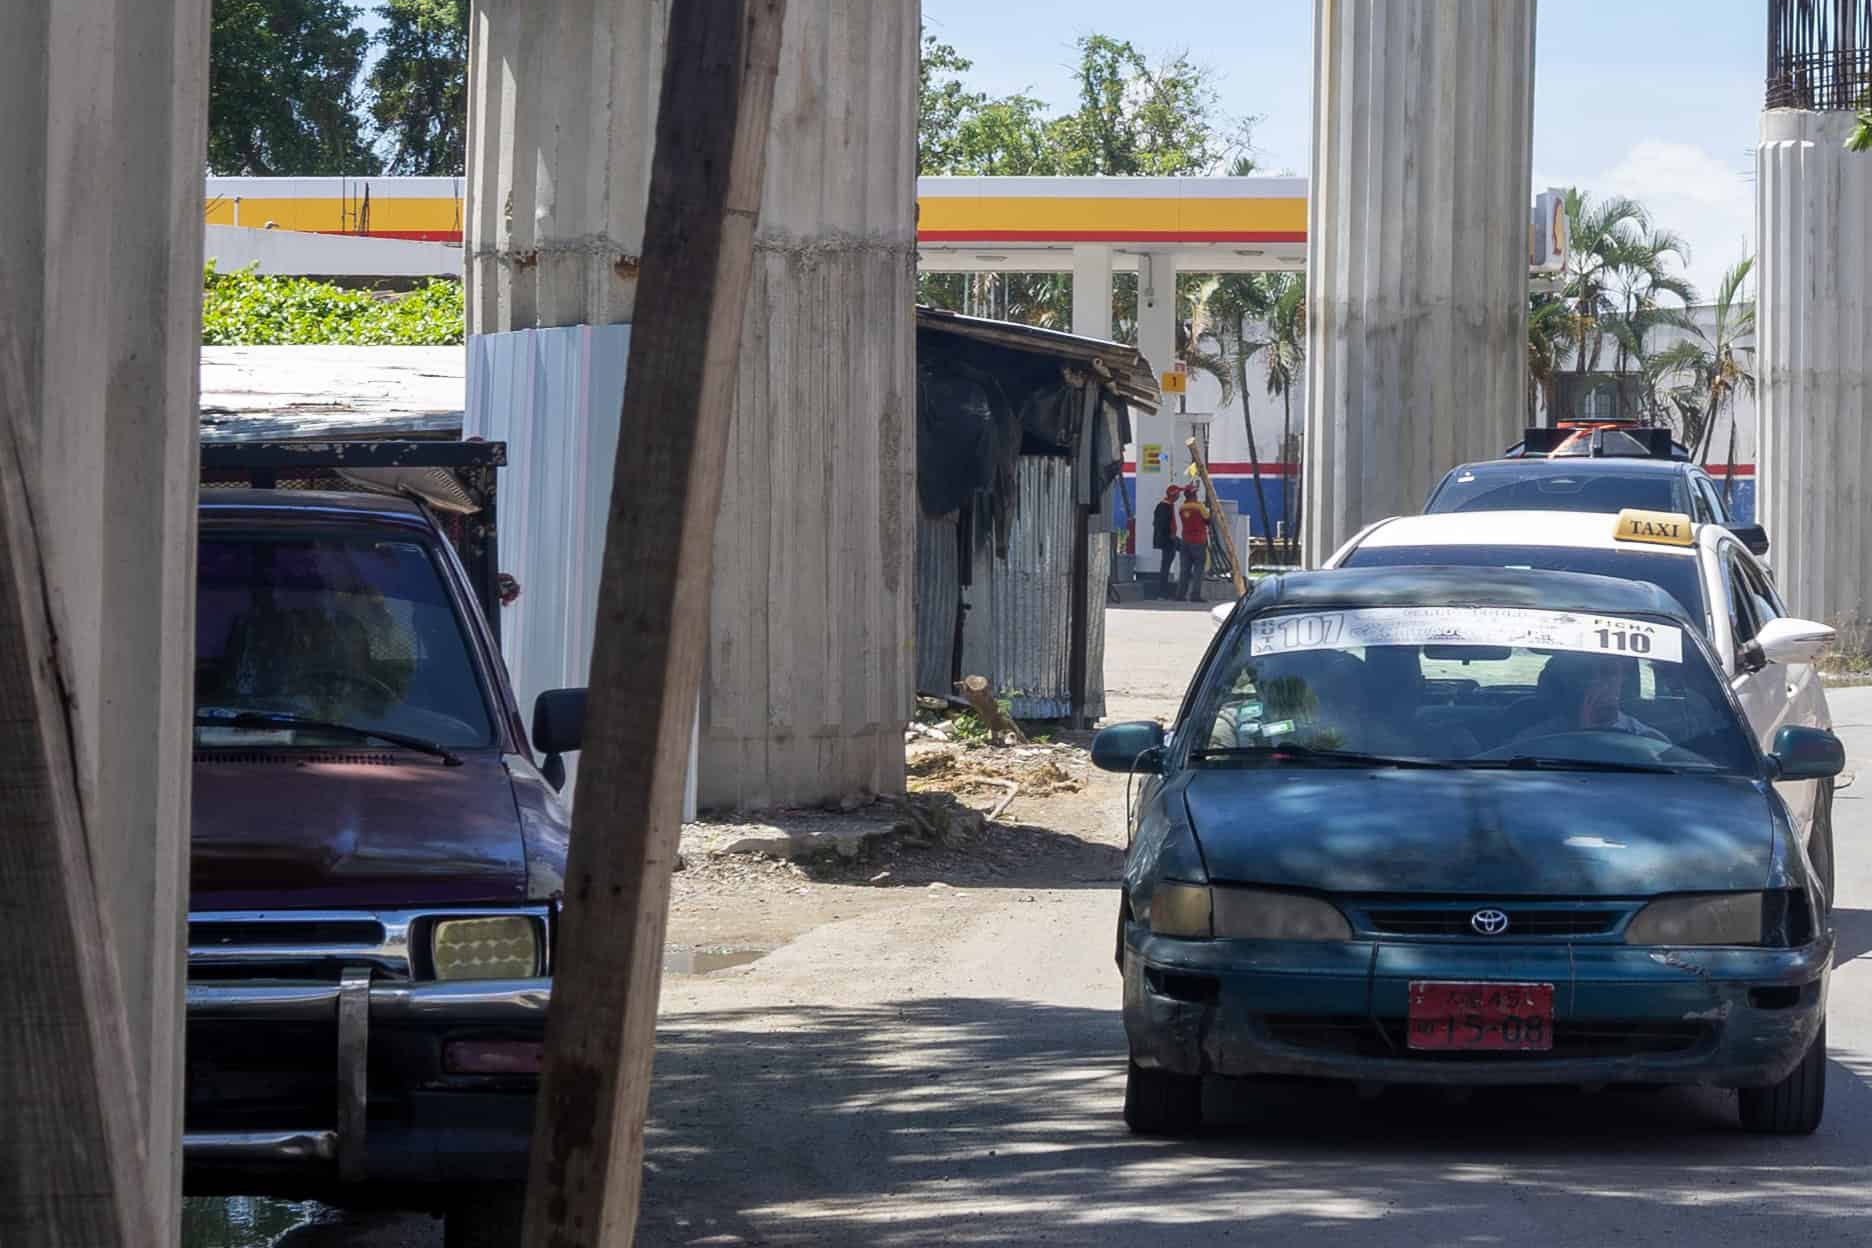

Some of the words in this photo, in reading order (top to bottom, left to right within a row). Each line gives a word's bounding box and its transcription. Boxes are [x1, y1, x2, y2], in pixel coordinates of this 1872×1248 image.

[1631, 519, 1681, 538] TAXI
[1277, 613, 1345, 649] 107
[1594, 618, 1656, 634] FICHA
[1593, 628, 1651, 654] 110
